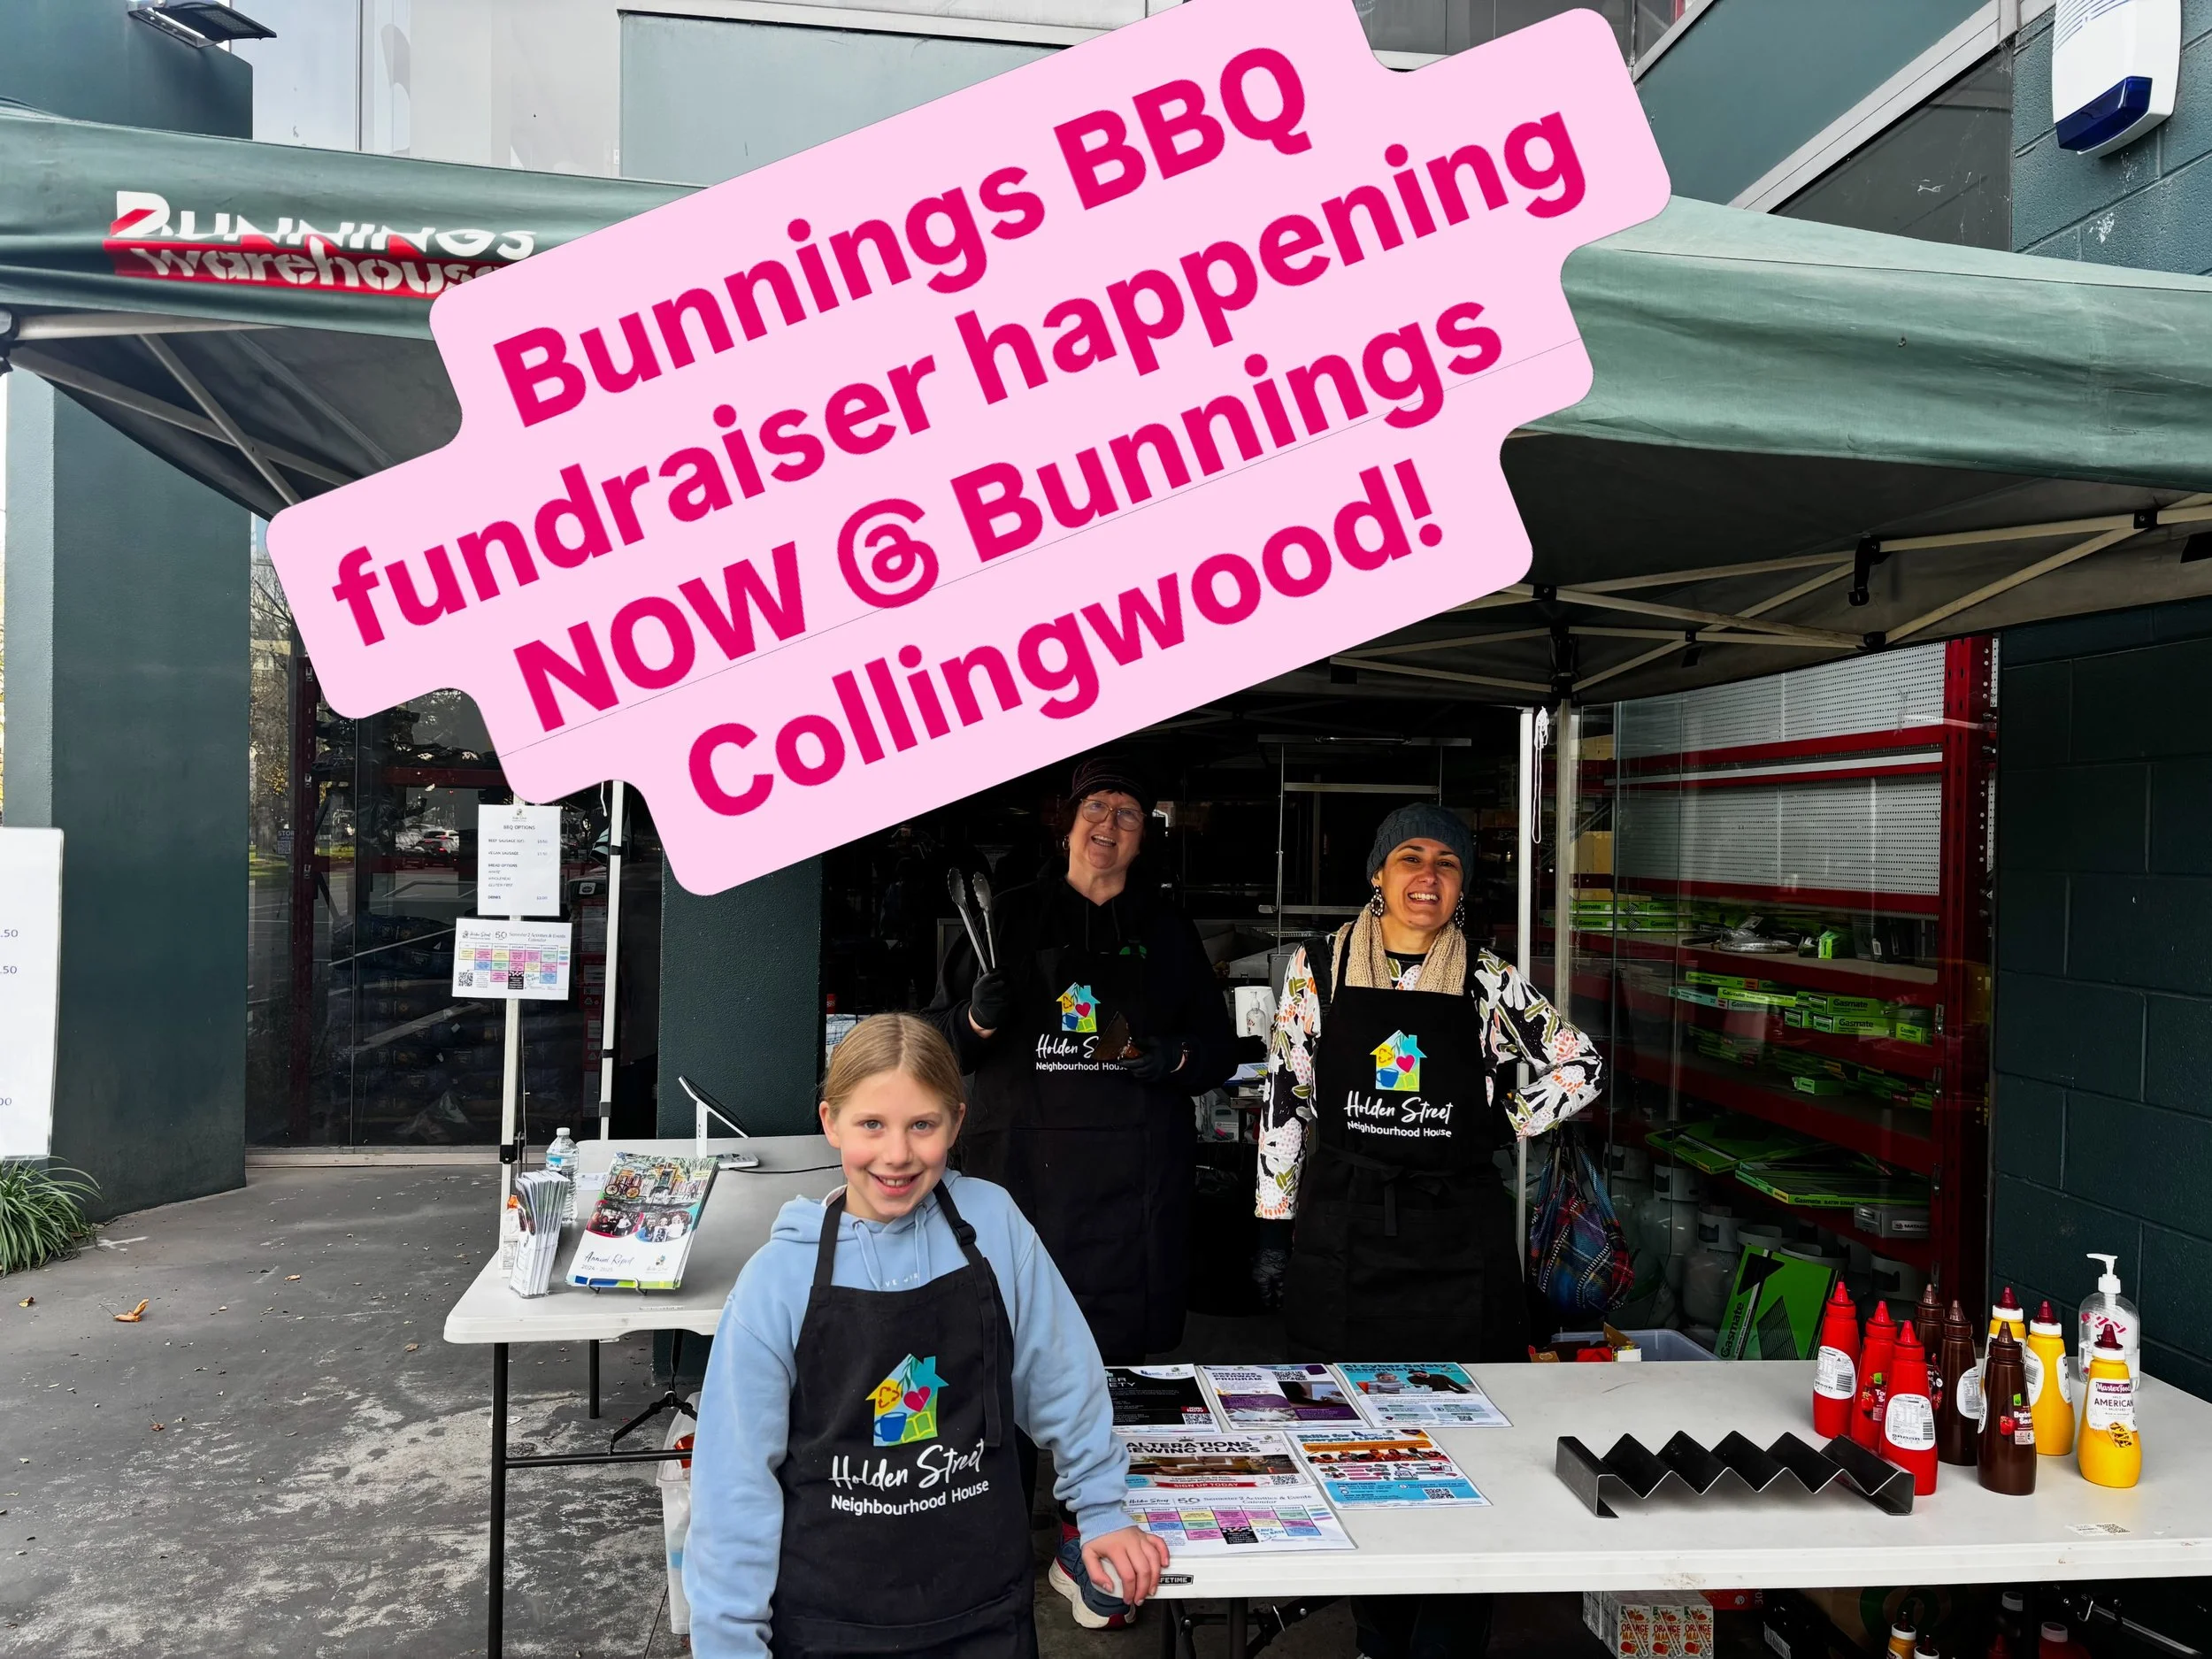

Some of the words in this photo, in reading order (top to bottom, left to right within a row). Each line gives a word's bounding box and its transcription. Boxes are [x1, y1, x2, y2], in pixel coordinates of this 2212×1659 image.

[111, 190, 537, 261] BUNNINGS
[130, 237, 503, 294] warehous
[1832, 998, 1868, 1009] Gasmate
[1839, 1018, 1874, 1028] Gasmate
[1035, 1033, 1079, 1059] Holden
[1035, 1062, 1099, 1072] Neighbourhood
[1344, 1090, 1395, 1119] Holden
[1401, 1097, 1454, 1125] Street
[1348, 1120, 1420, 1138] Neighbourhood
[1423, 1127, 1453, 1139] House
[1719, 1301, 1745, 1360] Gasmate
[2093, 1397, 2133, 1408] AMERICAN
[828, 1455, 909, 1491] Holden
[917, 1438, 986, 1489] Street
[831, 1492, 947, 1517] Neighbourhood
[951, 1479, 990, 1503] House
